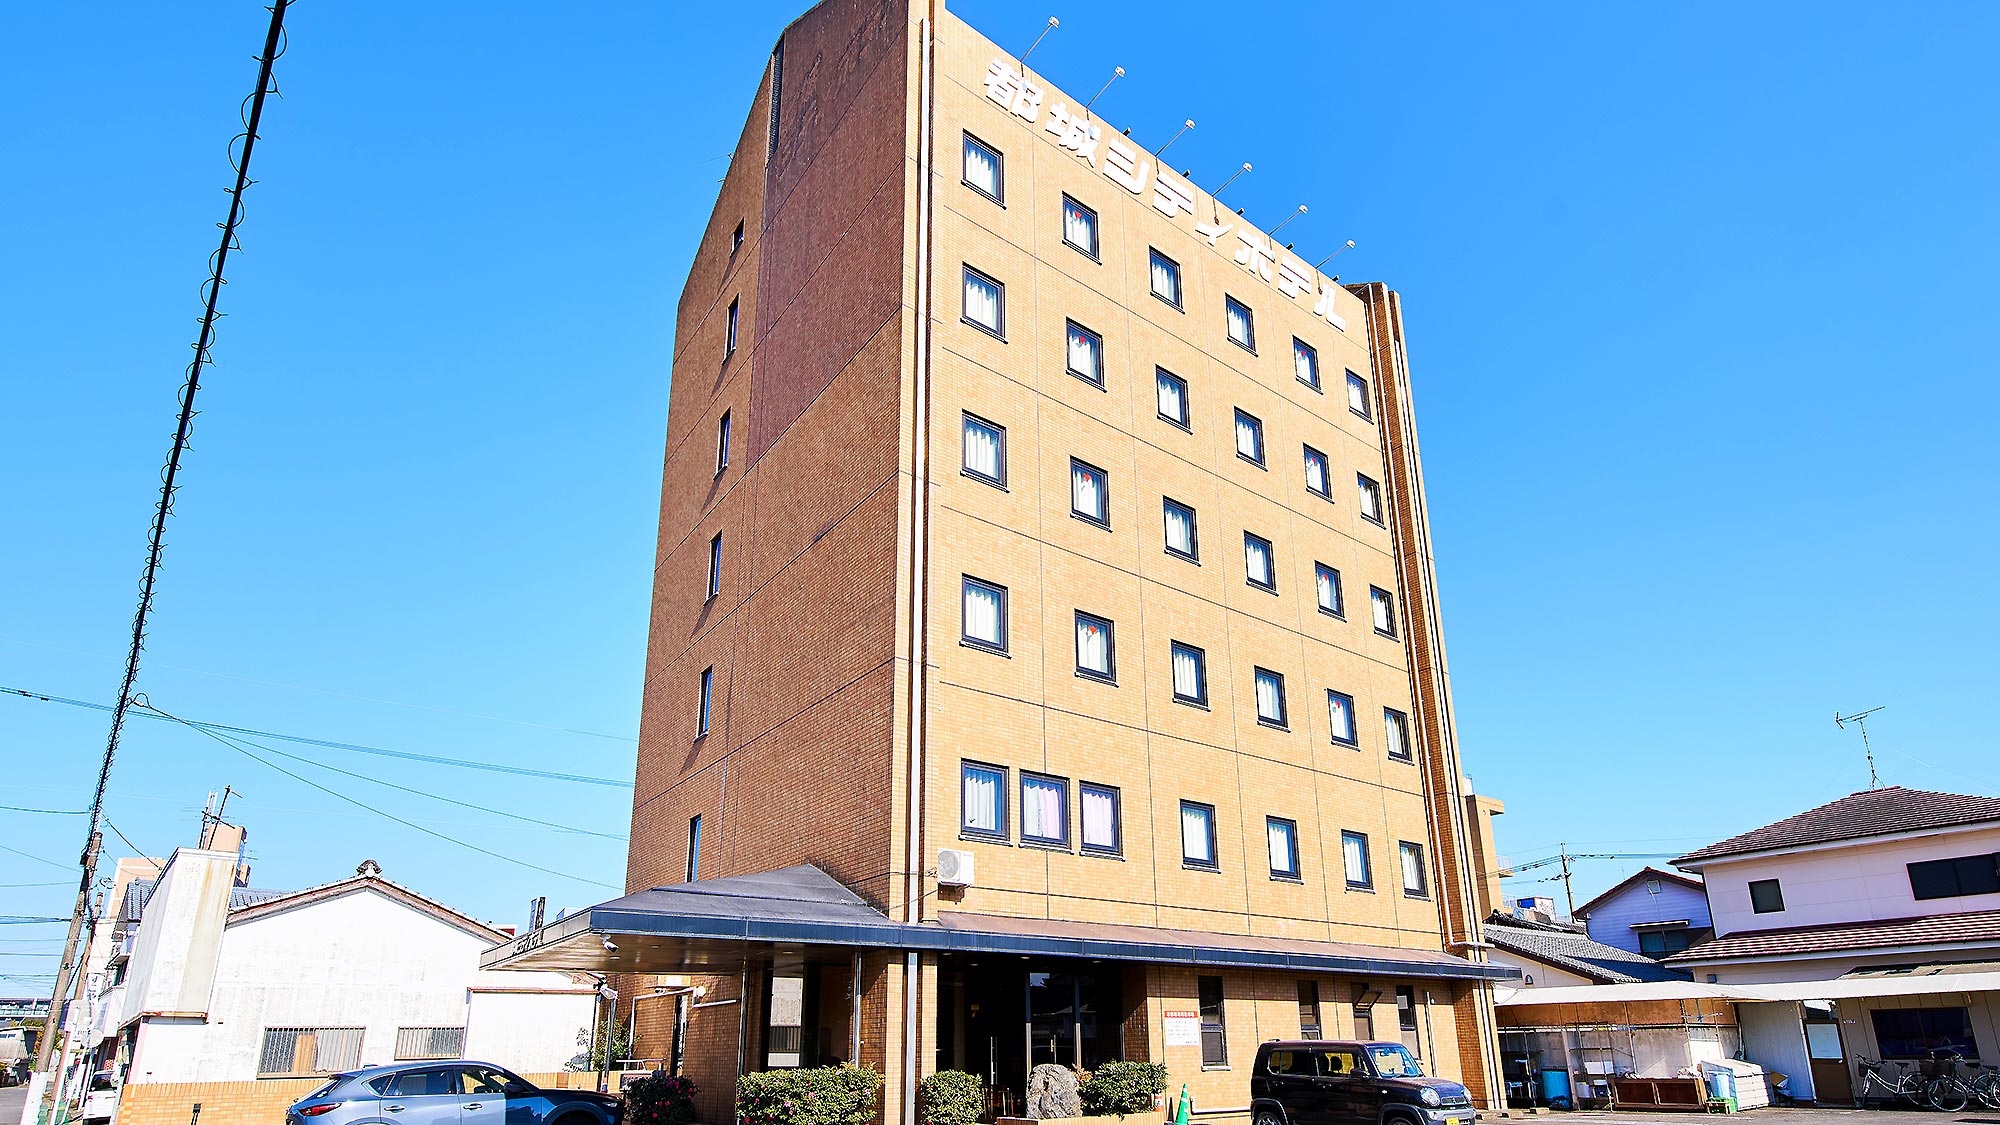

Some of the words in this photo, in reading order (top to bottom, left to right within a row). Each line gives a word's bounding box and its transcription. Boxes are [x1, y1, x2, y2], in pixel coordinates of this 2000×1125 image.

[983, 58, 1346, 332] 都城シティホテル
